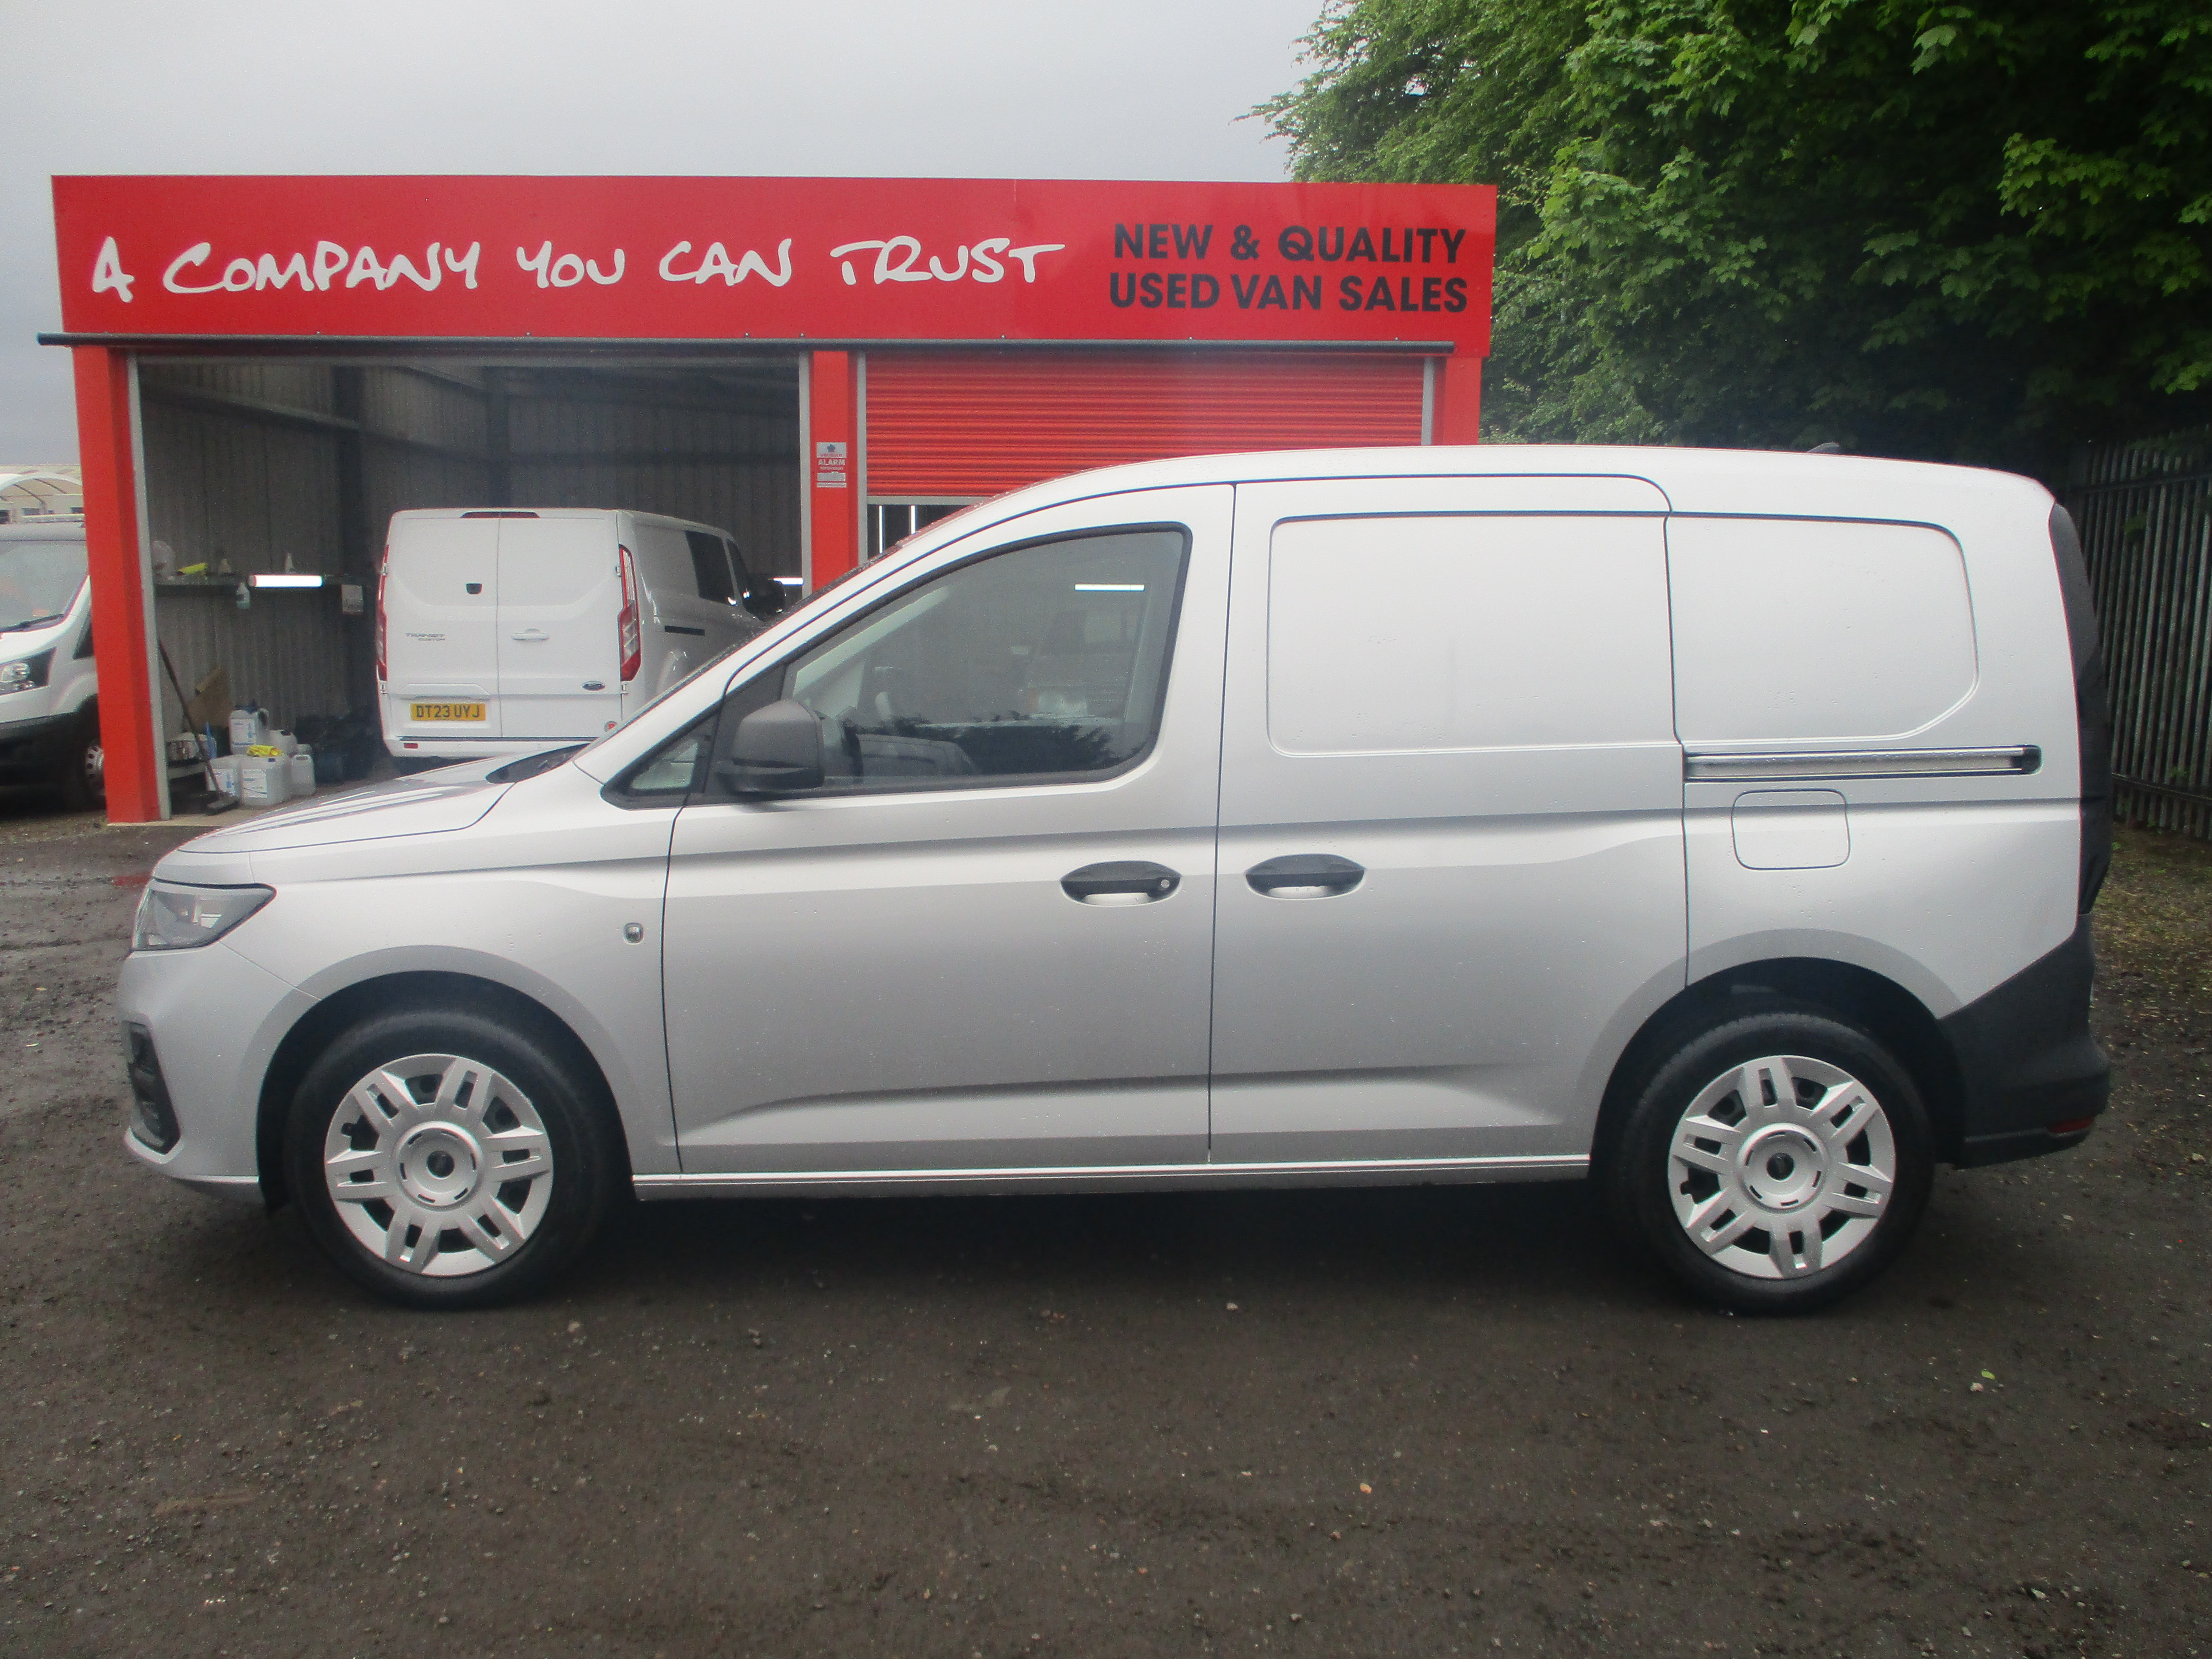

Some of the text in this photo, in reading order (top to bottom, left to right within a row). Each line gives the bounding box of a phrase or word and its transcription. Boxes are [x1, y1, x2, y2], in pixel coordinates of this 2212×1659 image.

[1114, 223, 1467, 264] NEW & QUALITY
[92, 235, 1066, 303] A COMPANY YOU CAN TRUST
[1109, 272, 1468, 313] USED VAN SALES
[416, 705, 480, 718] DT23 UYJ
